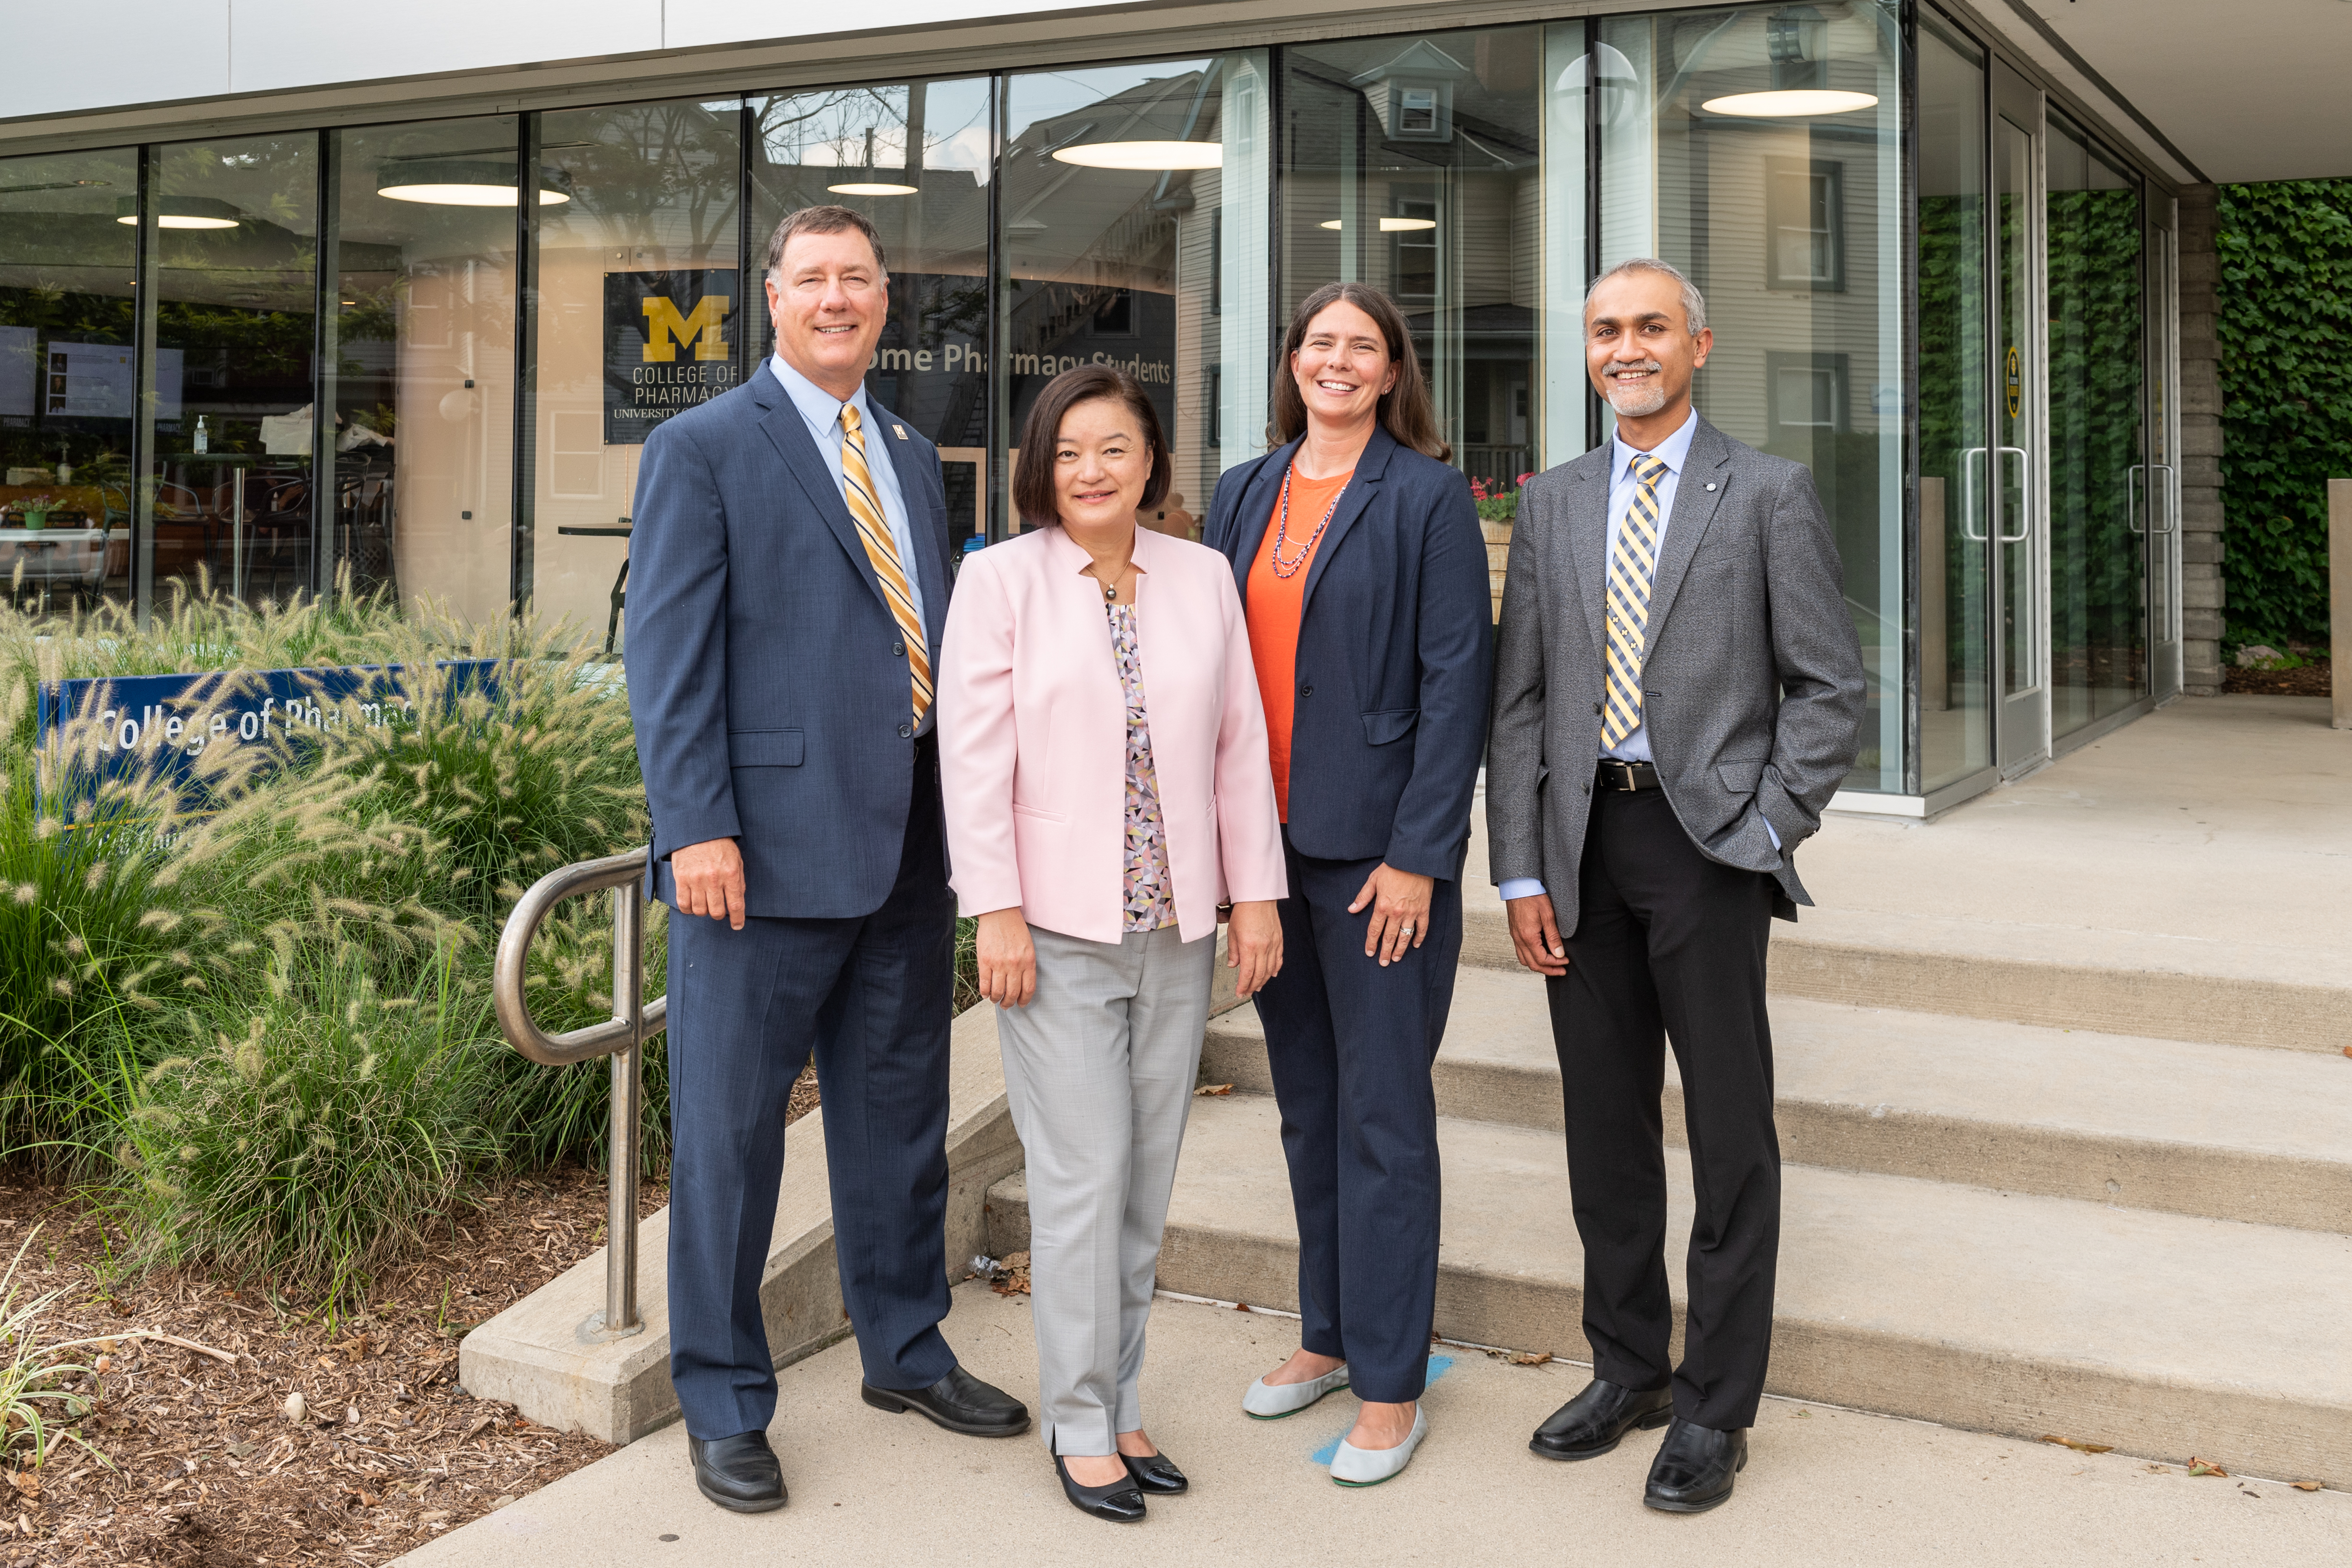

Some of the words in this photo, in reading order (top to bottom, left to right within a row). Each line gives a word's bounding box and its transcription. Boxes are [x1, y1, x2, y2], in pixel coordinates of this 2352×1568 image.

[642, 295, 729, 362] M
[633, 366, 707, 384] COLLEGE
[717, 366, 737, 383] OF
[635, 386, 735, 404] PHARMAC
[614, 408, 679, 419] UNIVERSITY
[240, 697, 274, 740] of
